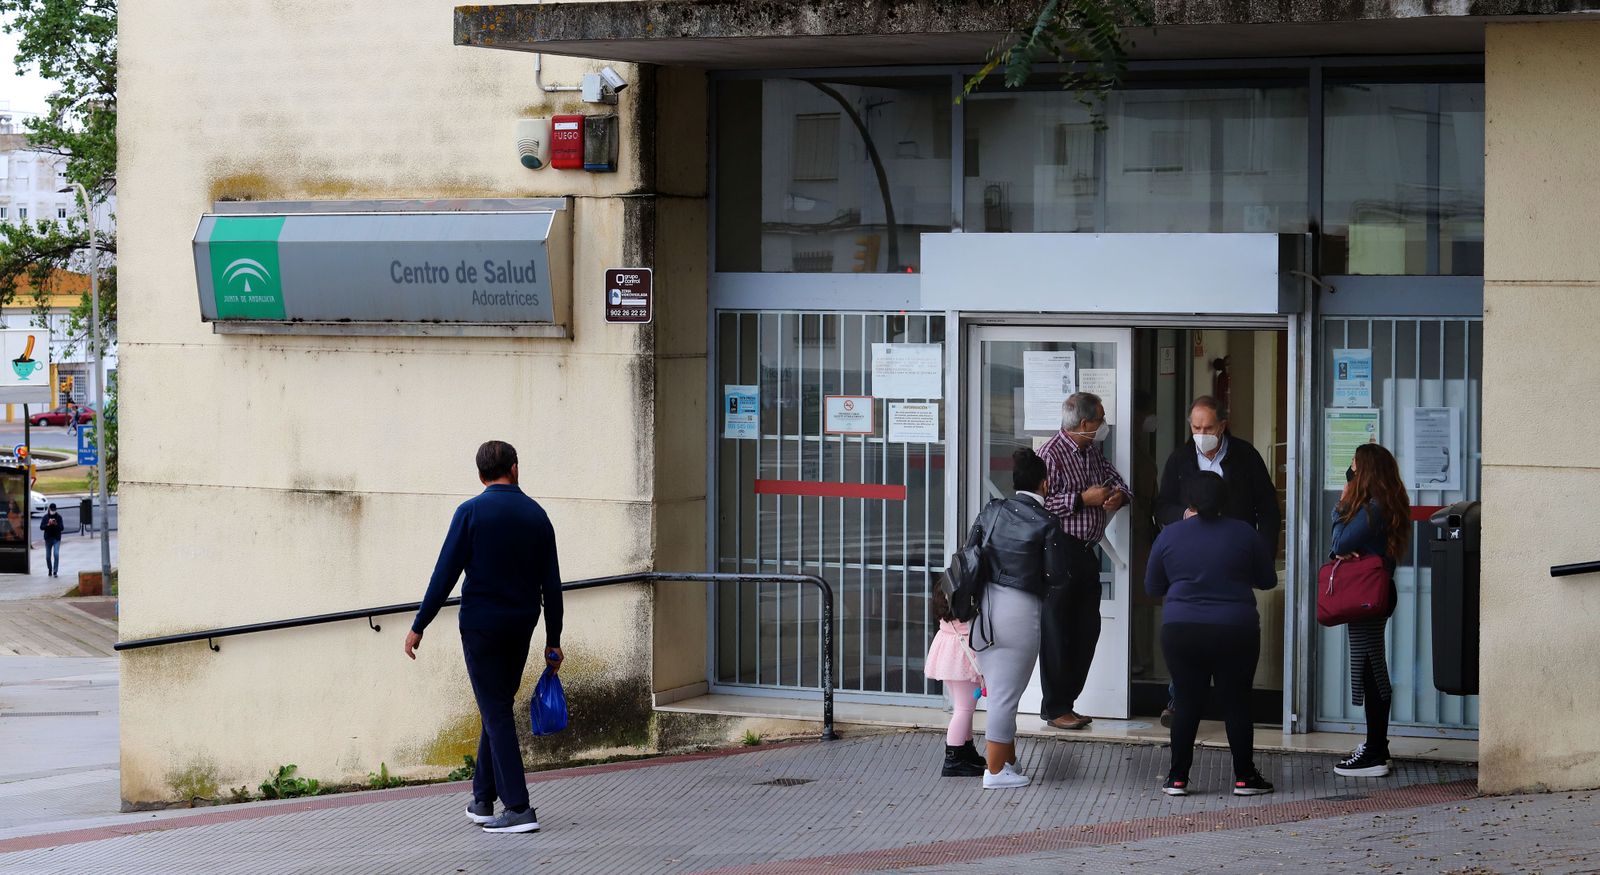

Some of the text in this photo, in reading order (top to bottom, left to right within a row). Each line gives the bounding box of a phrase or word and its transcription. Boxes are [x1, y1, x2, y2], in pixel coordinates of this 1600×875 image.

[554, 131, 578, 140] FUEGO
[390, 260, 537, 284] Centro de Salud
[224, 295, 239, 303] JUNTA
[240, 295, 247, 303] DE
[472, 290, 539, 306] Adoratrices
